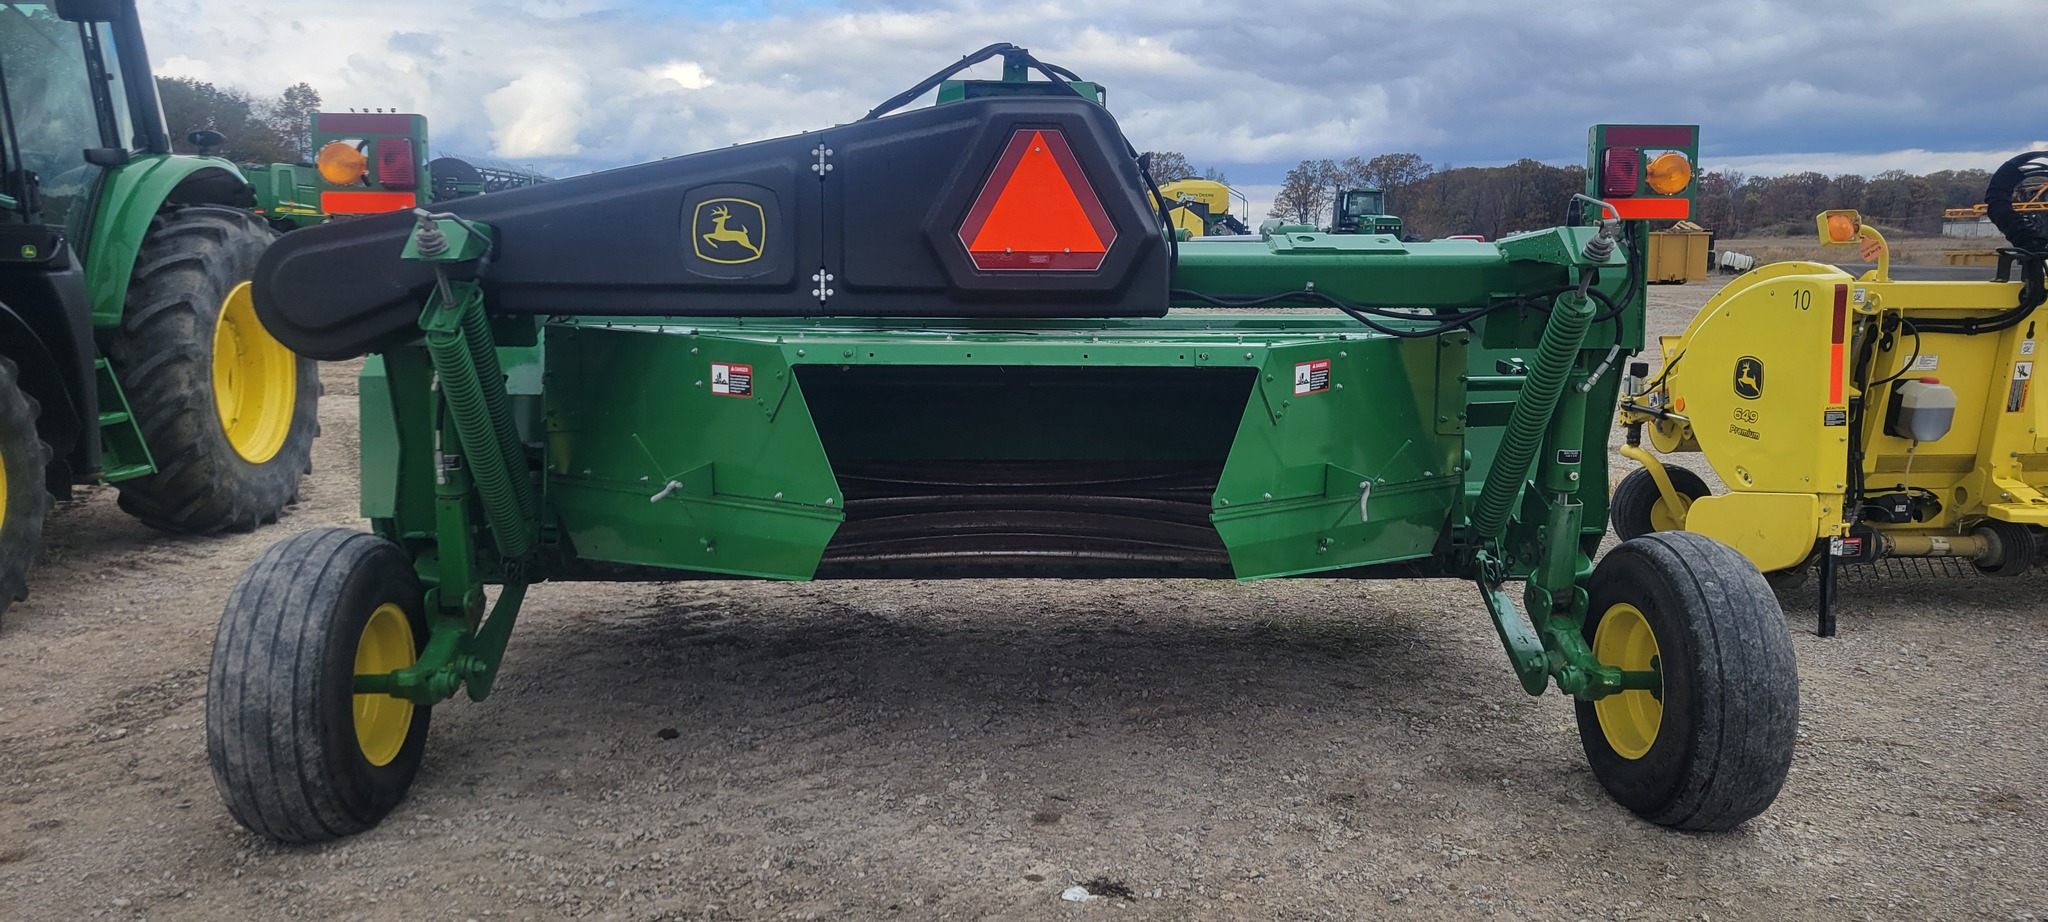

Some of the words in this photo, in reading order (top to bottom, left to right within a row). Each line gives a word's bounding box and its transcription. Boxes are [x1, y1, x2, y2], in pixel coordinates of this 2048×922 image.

[1793, 289, 1811, 311] 10
[1733, 407, 1759, 424] 649
[1729, 423, 1761, 441] Premium
